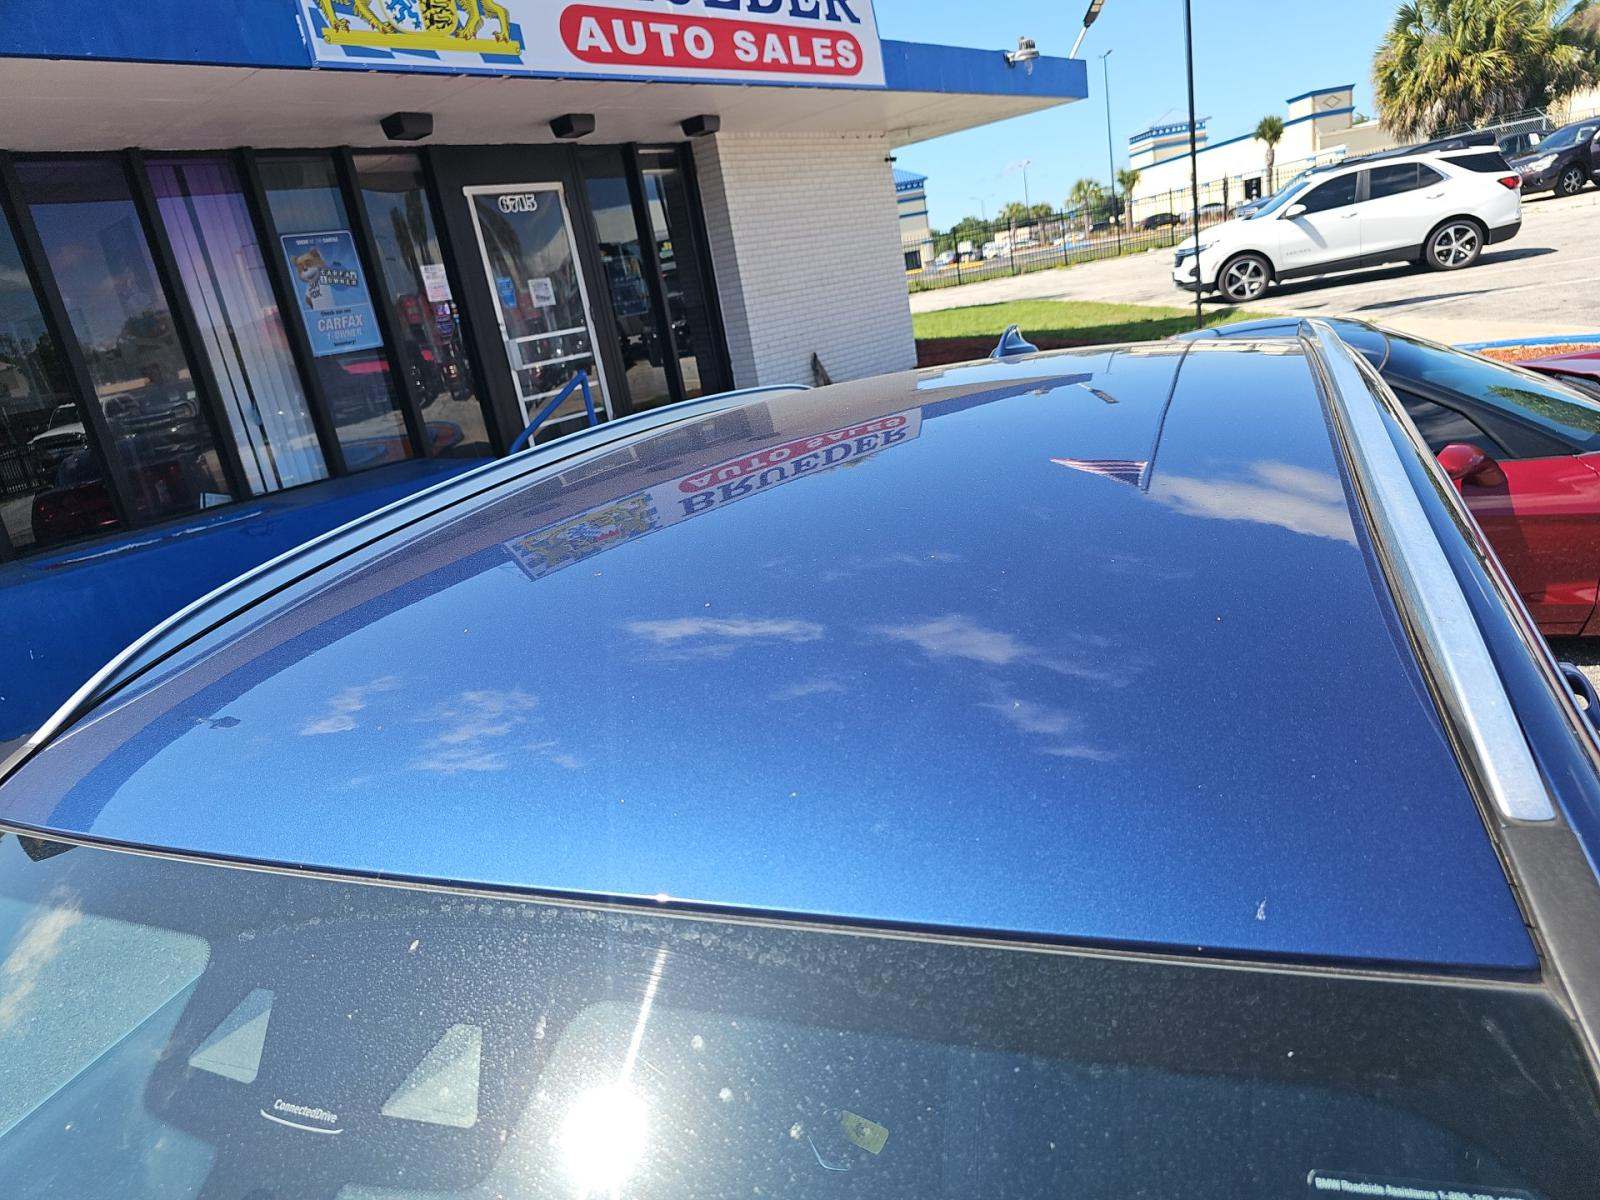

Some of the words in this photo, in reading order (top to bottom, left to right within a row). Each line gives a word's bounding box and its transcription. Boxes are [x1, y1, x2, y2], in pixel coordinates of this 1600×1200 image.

[576, 15, 716, 59] AUTO
[732, 29, 858, 69] SALES
[317, 313, 364, 332] CARFAX
[273, 1098, 338, 1123] ConnectedDrive
[1341, 1179, 1386, 1196] Roadside
